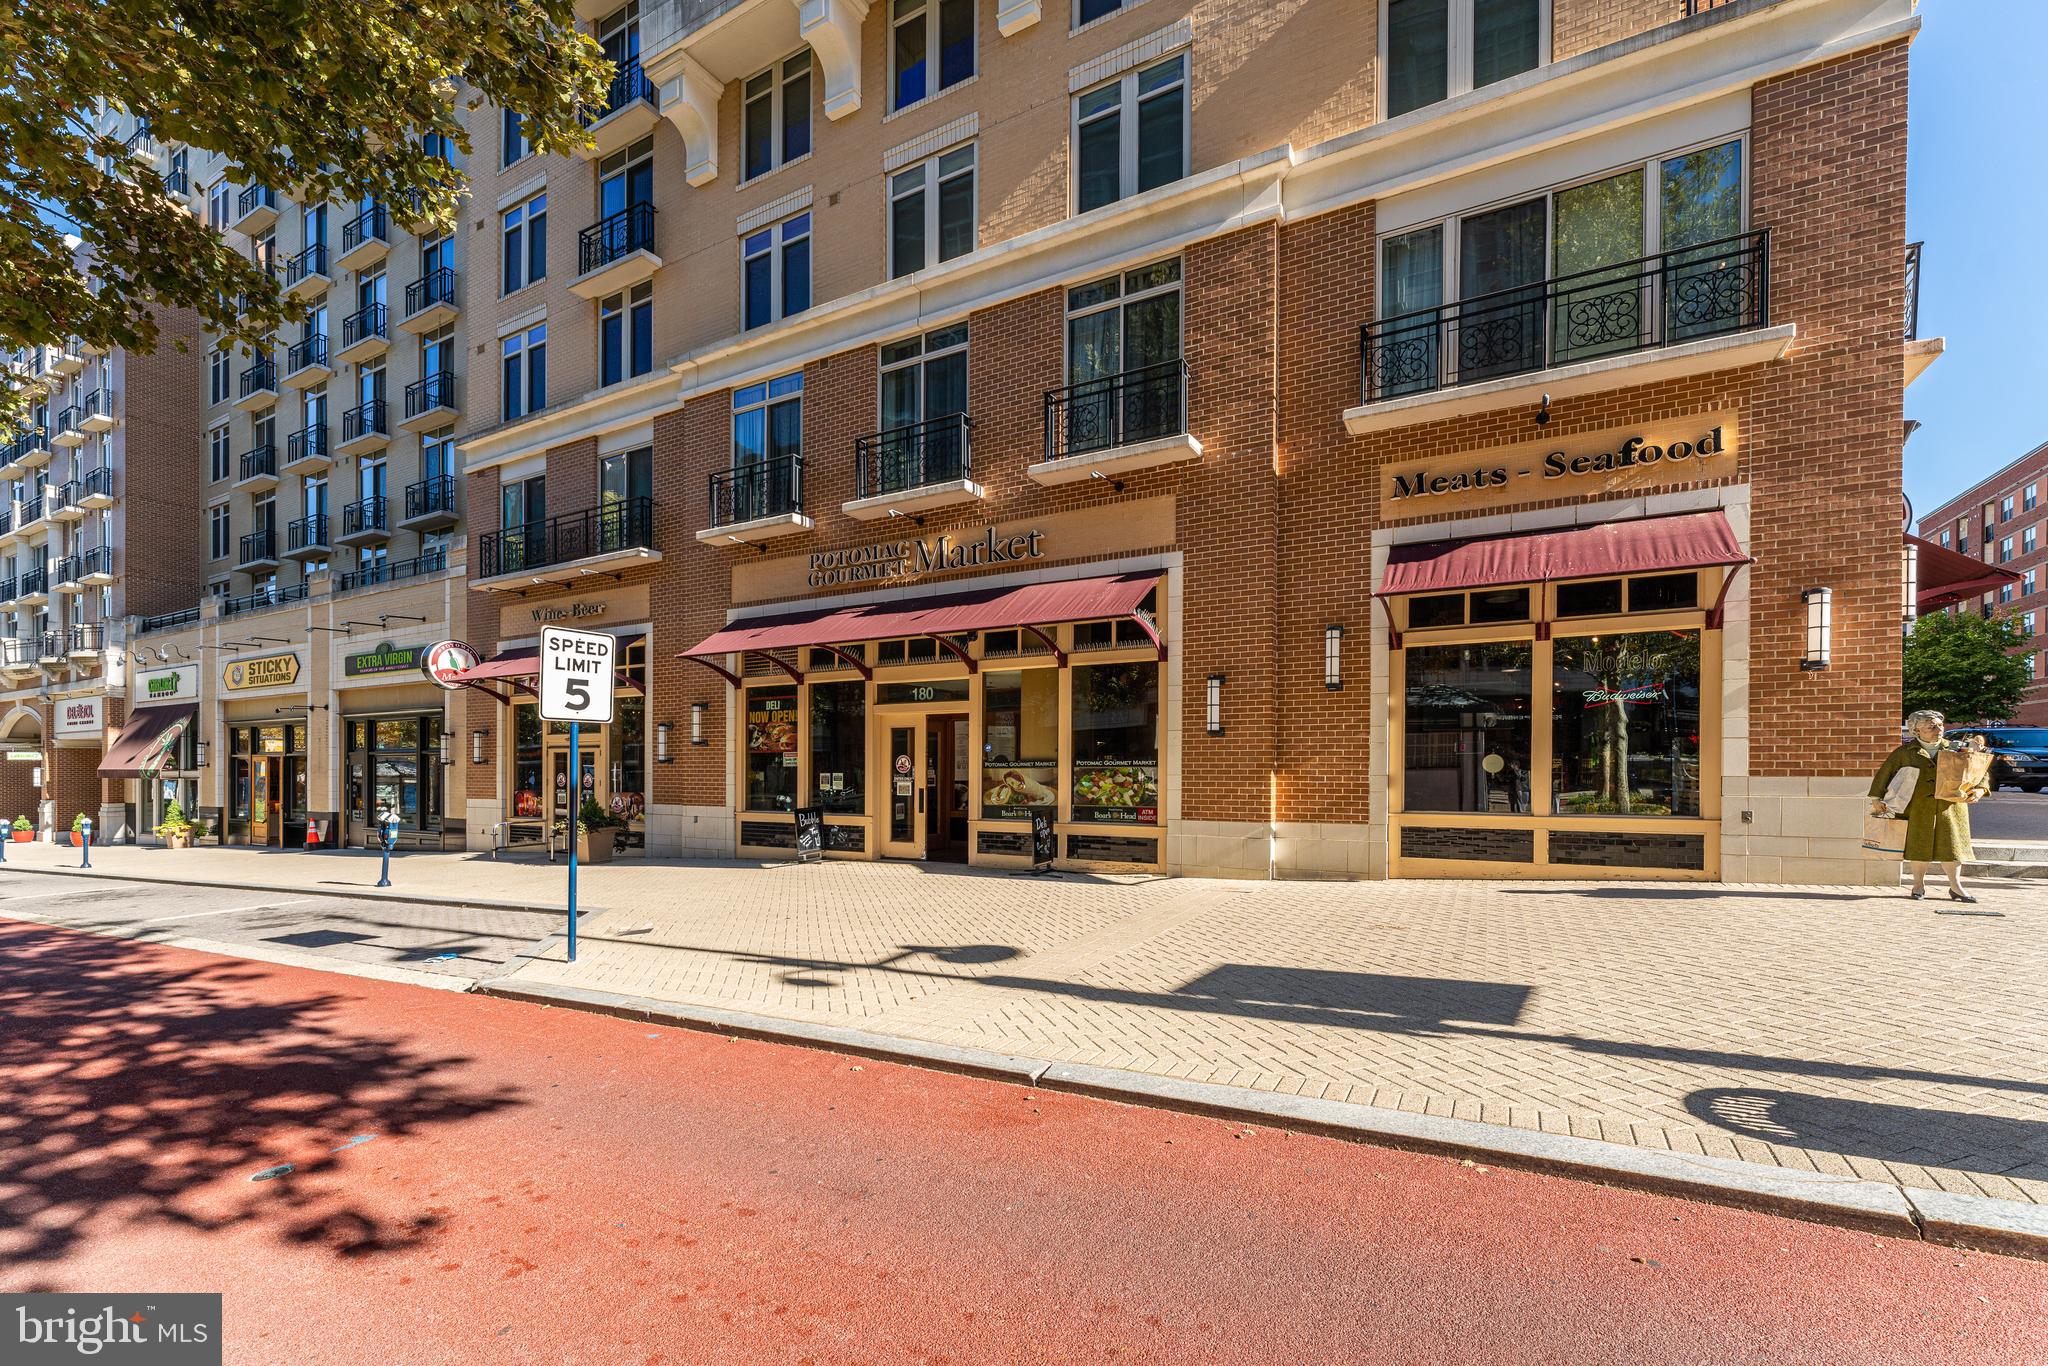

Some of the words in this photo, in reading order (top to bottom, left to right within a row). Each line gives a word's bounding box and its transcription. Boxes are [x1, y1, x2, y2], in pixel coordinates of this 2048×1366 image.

[1391, 465, 1508, 499] Meats
[1544, 426, 1725, 478] Seafood
[809, 541, 911, 570] POTOMAC
[914, 528, 1045, 573] Market
[808, 560, 905, 587] GOURMET
[573, 603, 606, 618] Beer
[549, 637, 608, 656] SPEED
[248, 657, 291, 675] STICKY
[357, 655, 382, 669] EXTRA
[385, 651, 413, 665] VIRGIN
[555, 656, 602, 674] LIMIT
[1583, 648, 1664, 673] Modelo
[248, 672, 291, 685] SITUATIONS
[564, 678, 590, 711] 5
[912, 687, 934, 700] 180
[1583, 690, 1660, 702] Budweiser
[766, 700, 780, 710] DELI
[749, 711, 769, 723] NOW
